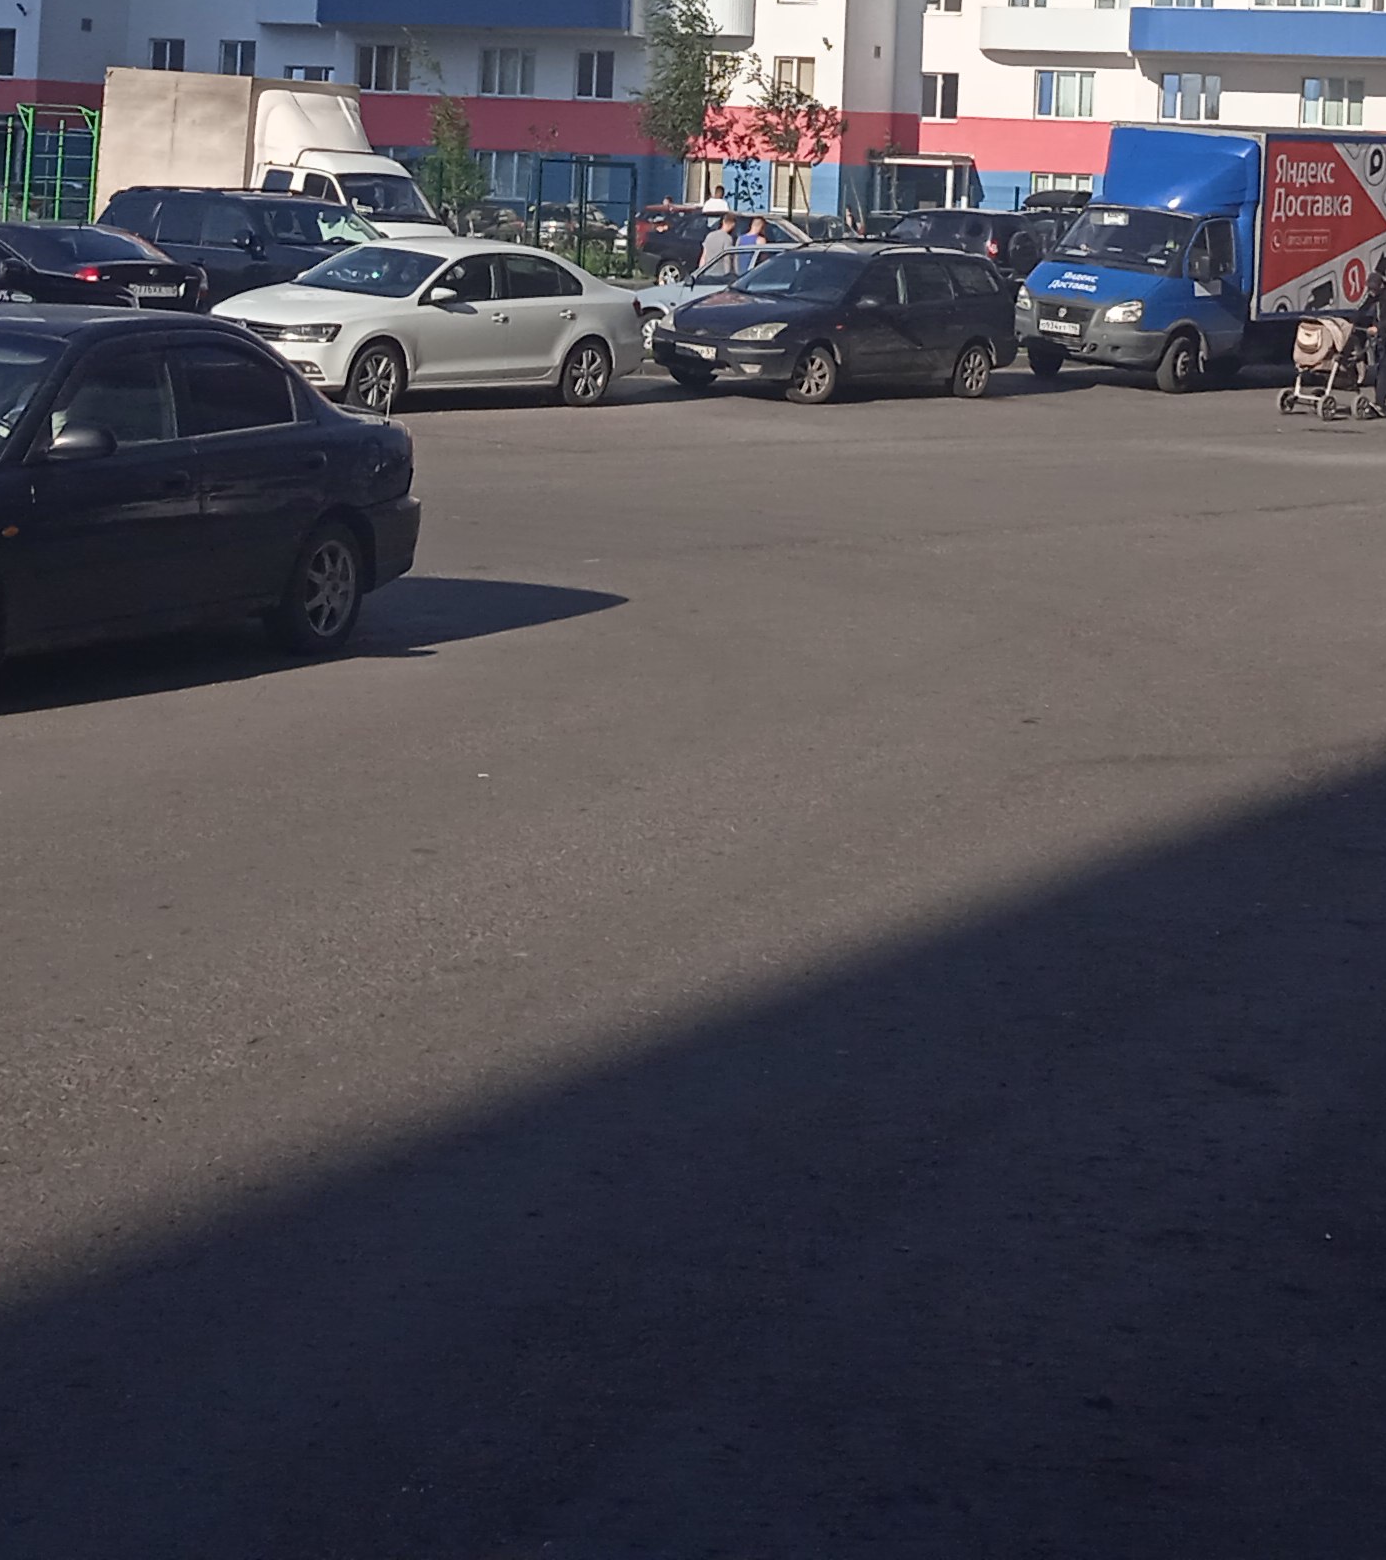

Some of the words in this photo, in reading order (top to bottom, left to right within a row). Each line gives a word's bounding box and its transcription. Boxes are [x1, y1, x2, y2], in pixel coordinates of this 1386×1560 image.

[1275, 154, 1335, 187] Яндекс
[1271, 188, 1352, 222] Доставка
[1047, 279, 1098, 293] Доставка
[1062, 271, 1099, 283] Яндекс
[1348, 264, 1361, 297] Я
